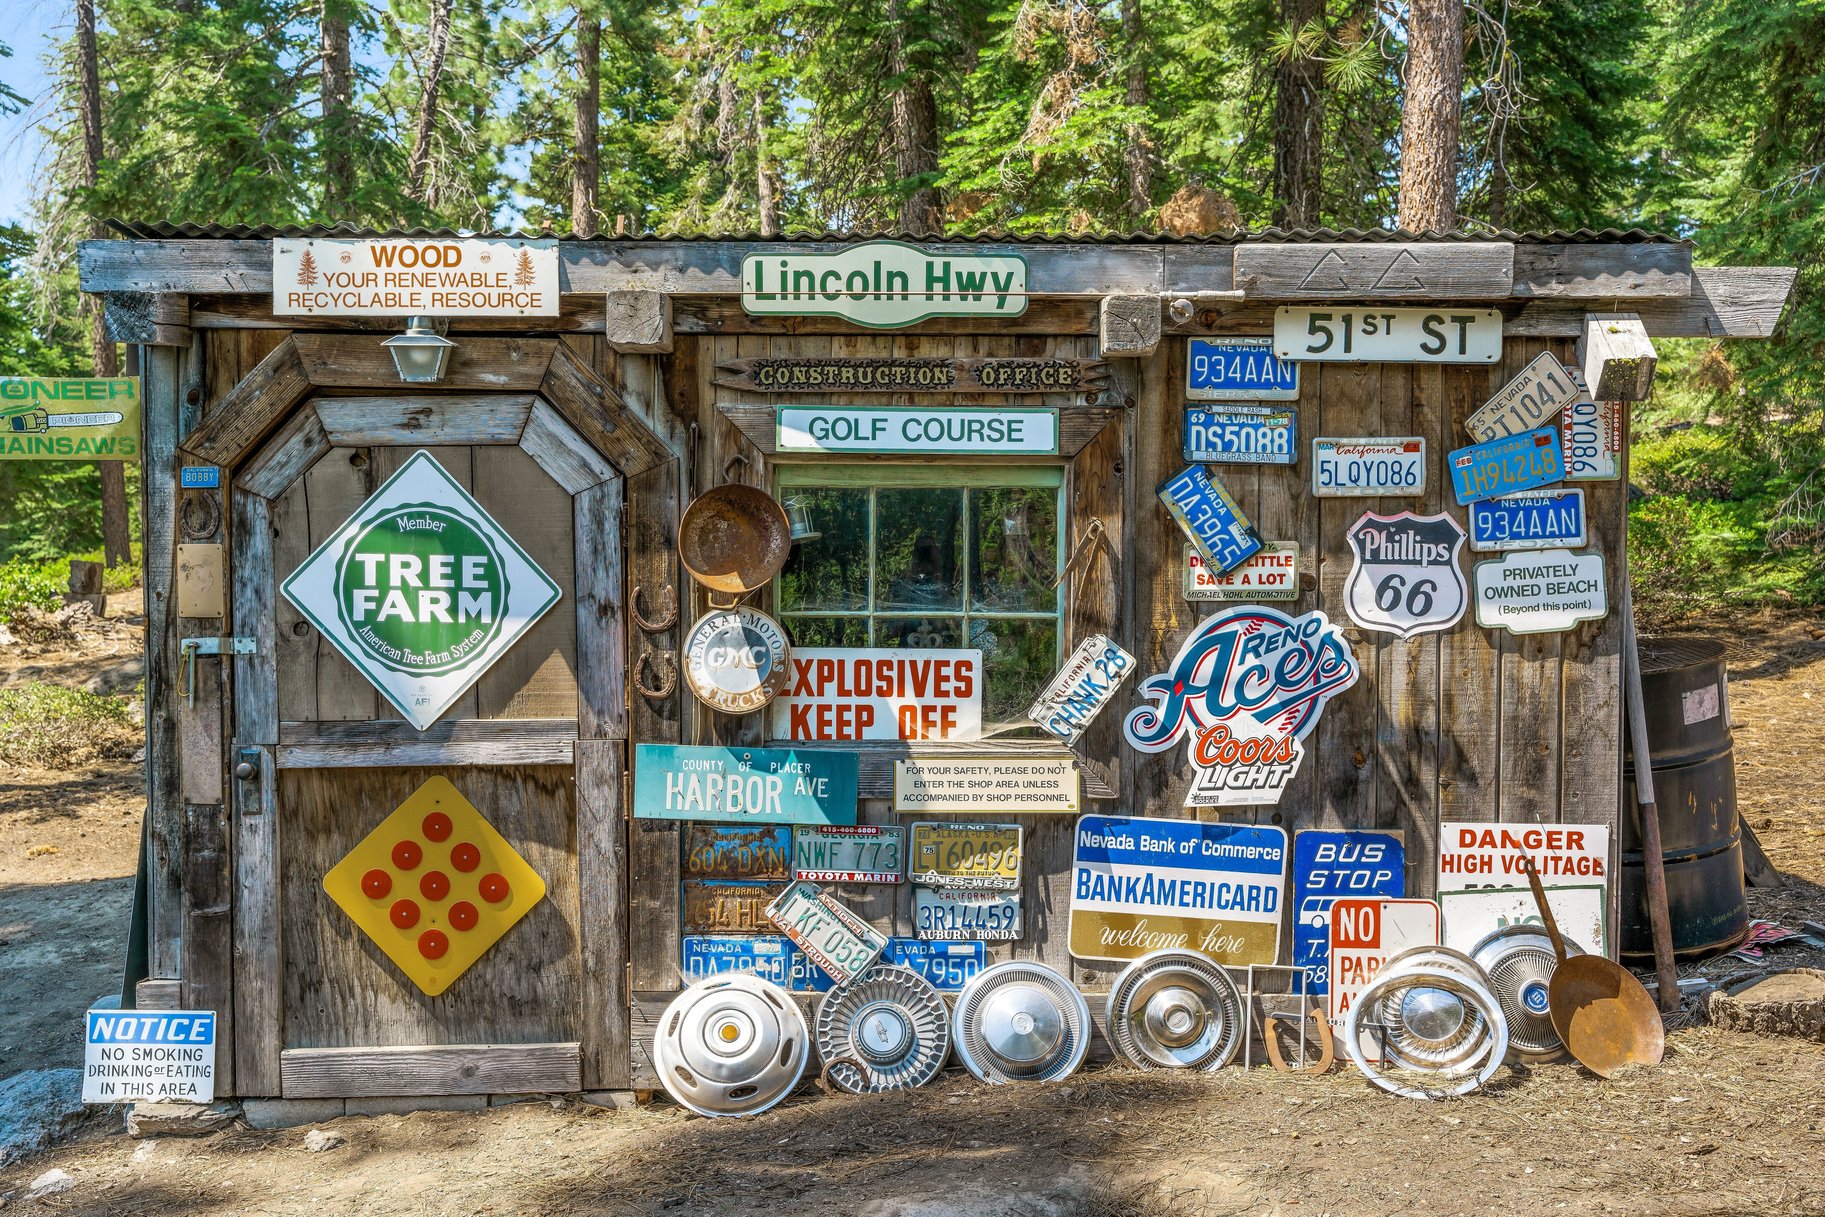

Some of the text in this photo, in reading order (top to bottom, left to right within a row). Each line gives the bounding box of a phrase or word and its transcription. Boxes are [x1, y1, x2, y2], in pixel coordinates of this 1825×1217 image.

[370, 245, 462, 268] WOOD
[323, 272, 513, 291] YOUR RENEWABLE,
[754, 260, 1015, 310] Lincoln Hwy
[288, 292, 543, 310] RECYCLABLE, RESOURCE
[1419, 314, 1476, 355] ST
[758, 366, 1072, 386] CONSTRUCTION OFFICE
[1194, 355, 1291, 382] 934AAN
[1489, 375, 1533, 415] NEVADA
[51, 414, 116, 425] PIONEER
[808, 416, 1025, 442] GOLF COURSE
[1190, 413, 1206, 423] 69
[1214, 414, 1265, 424] NEVADA
[1471, 416, 1486, 431] 65
[1191, 425, 1289, 454] DS5088
[1318, 443, 1335, 451] MAR
[1563, 429, 1572, 472] MARIN
[1205, 452, 1277, 462] BLUEGRASS BAND
[1336, 444, 1404, 459] California
[185, 472, 214, 482] BOBBY
[1320, 460, 1417, 487] 5LQY086
[1461, 447, 1557, 496] 1H94248
[1193, 471, 1228, 517] NEVADA
[1501, 498, 1551, 507] NEVADA
[396, 515, 447, 532] Member
[1167, 476, 1242, 567] DA3965
[1478, 508, 1576, 539] 934AAN
[1359, 527, 1451, 568] Phillips
[355, 554, 488, 588] TREE
[1246, 556, 1293, 567] LITTLE
[1503, 563, 1579, 581] PRIVATELY
[1196, 574, 1287, 585] SAVE A LOT
[1484, 580, 1598, 600] OWNED BEACH
[353, 589, 492, 623] FARM
[1375, 574, 1438, 618] 66
[1498, 599, 1592, 615] (Beyond this point)
[359, 625, 485, 665] American Tree Farm System
[690, 613, 784, 673] GENERAL MOTORS
[1238, 617, 1322, 666] RENO
[707, 646, 767, 669] GMC
[1050, 655, 1092, 703] CALIFORNIA
[1130, 629, 1354, 743] Aces
[702, 682, 774, 708] TRUCKS
[1049, 647, 1127, 737] CHAWK 28
[790, 704, 957, 740] KEEP OFF
[1194, 723, 1297, 766] Coors
[682, 759, 811, 774] COUNTY OF PLACER
[906, 766, 1067, 777] FOR YOUR SAFETY, PLEASE DO NOT
[1197, 764, 1293, 791] LIGHT
[665, 772, 829, 814] HARBOR AVE
[913, 780, 1059, 789] ENTER THE SHOP AREA UNLESS
[903, 793, 1071, 802] ACCOMPANIED BY SHOP PERSONNEL
[822, 825, 877, 834] 415-460-6800
[1458, 829, 1585, 850] DANGER
[797, 841, 897, 870] NWF 773
[1079, 831, 1281, 861] Nevada Bank of Commerce
[1314, 843, 1386, 863] BUS
[688, 846, 784, 873] 604 DXN
[1441, 854, 1493, 873] HIGH
[801, 872, 896, 882] TOYOTA MARIN
[916, 876, 1014, 888] JONES-WEST
[1306, 870, 1393, 889] STOP
[712, 888, 761, 896] CALIFORNIA
[939, 892, 996, 900] CALIFORNIA
[920, 905, 1015, 930] 3R14459
[1339, 906, 1376, 942] NO
[917, 930, 1019, 940] AUBURN HONDA
[1099, 918, 1246, 954] welcome here
[693, 943, 742, 953] NEVADA
[775, 912, 794, 933] VAL
[796, 935, 846, 981] STROUGH
[896, 945, 936, 954] EVADA
[92, 1017, 211, 1041] NOTICE
[101, 1048, 203, 1061] NO SMOKING
[88, 1065, 212, 1078] DRINKING or EATING
[100, 1082, 198, 1095] IN THIS AREA
